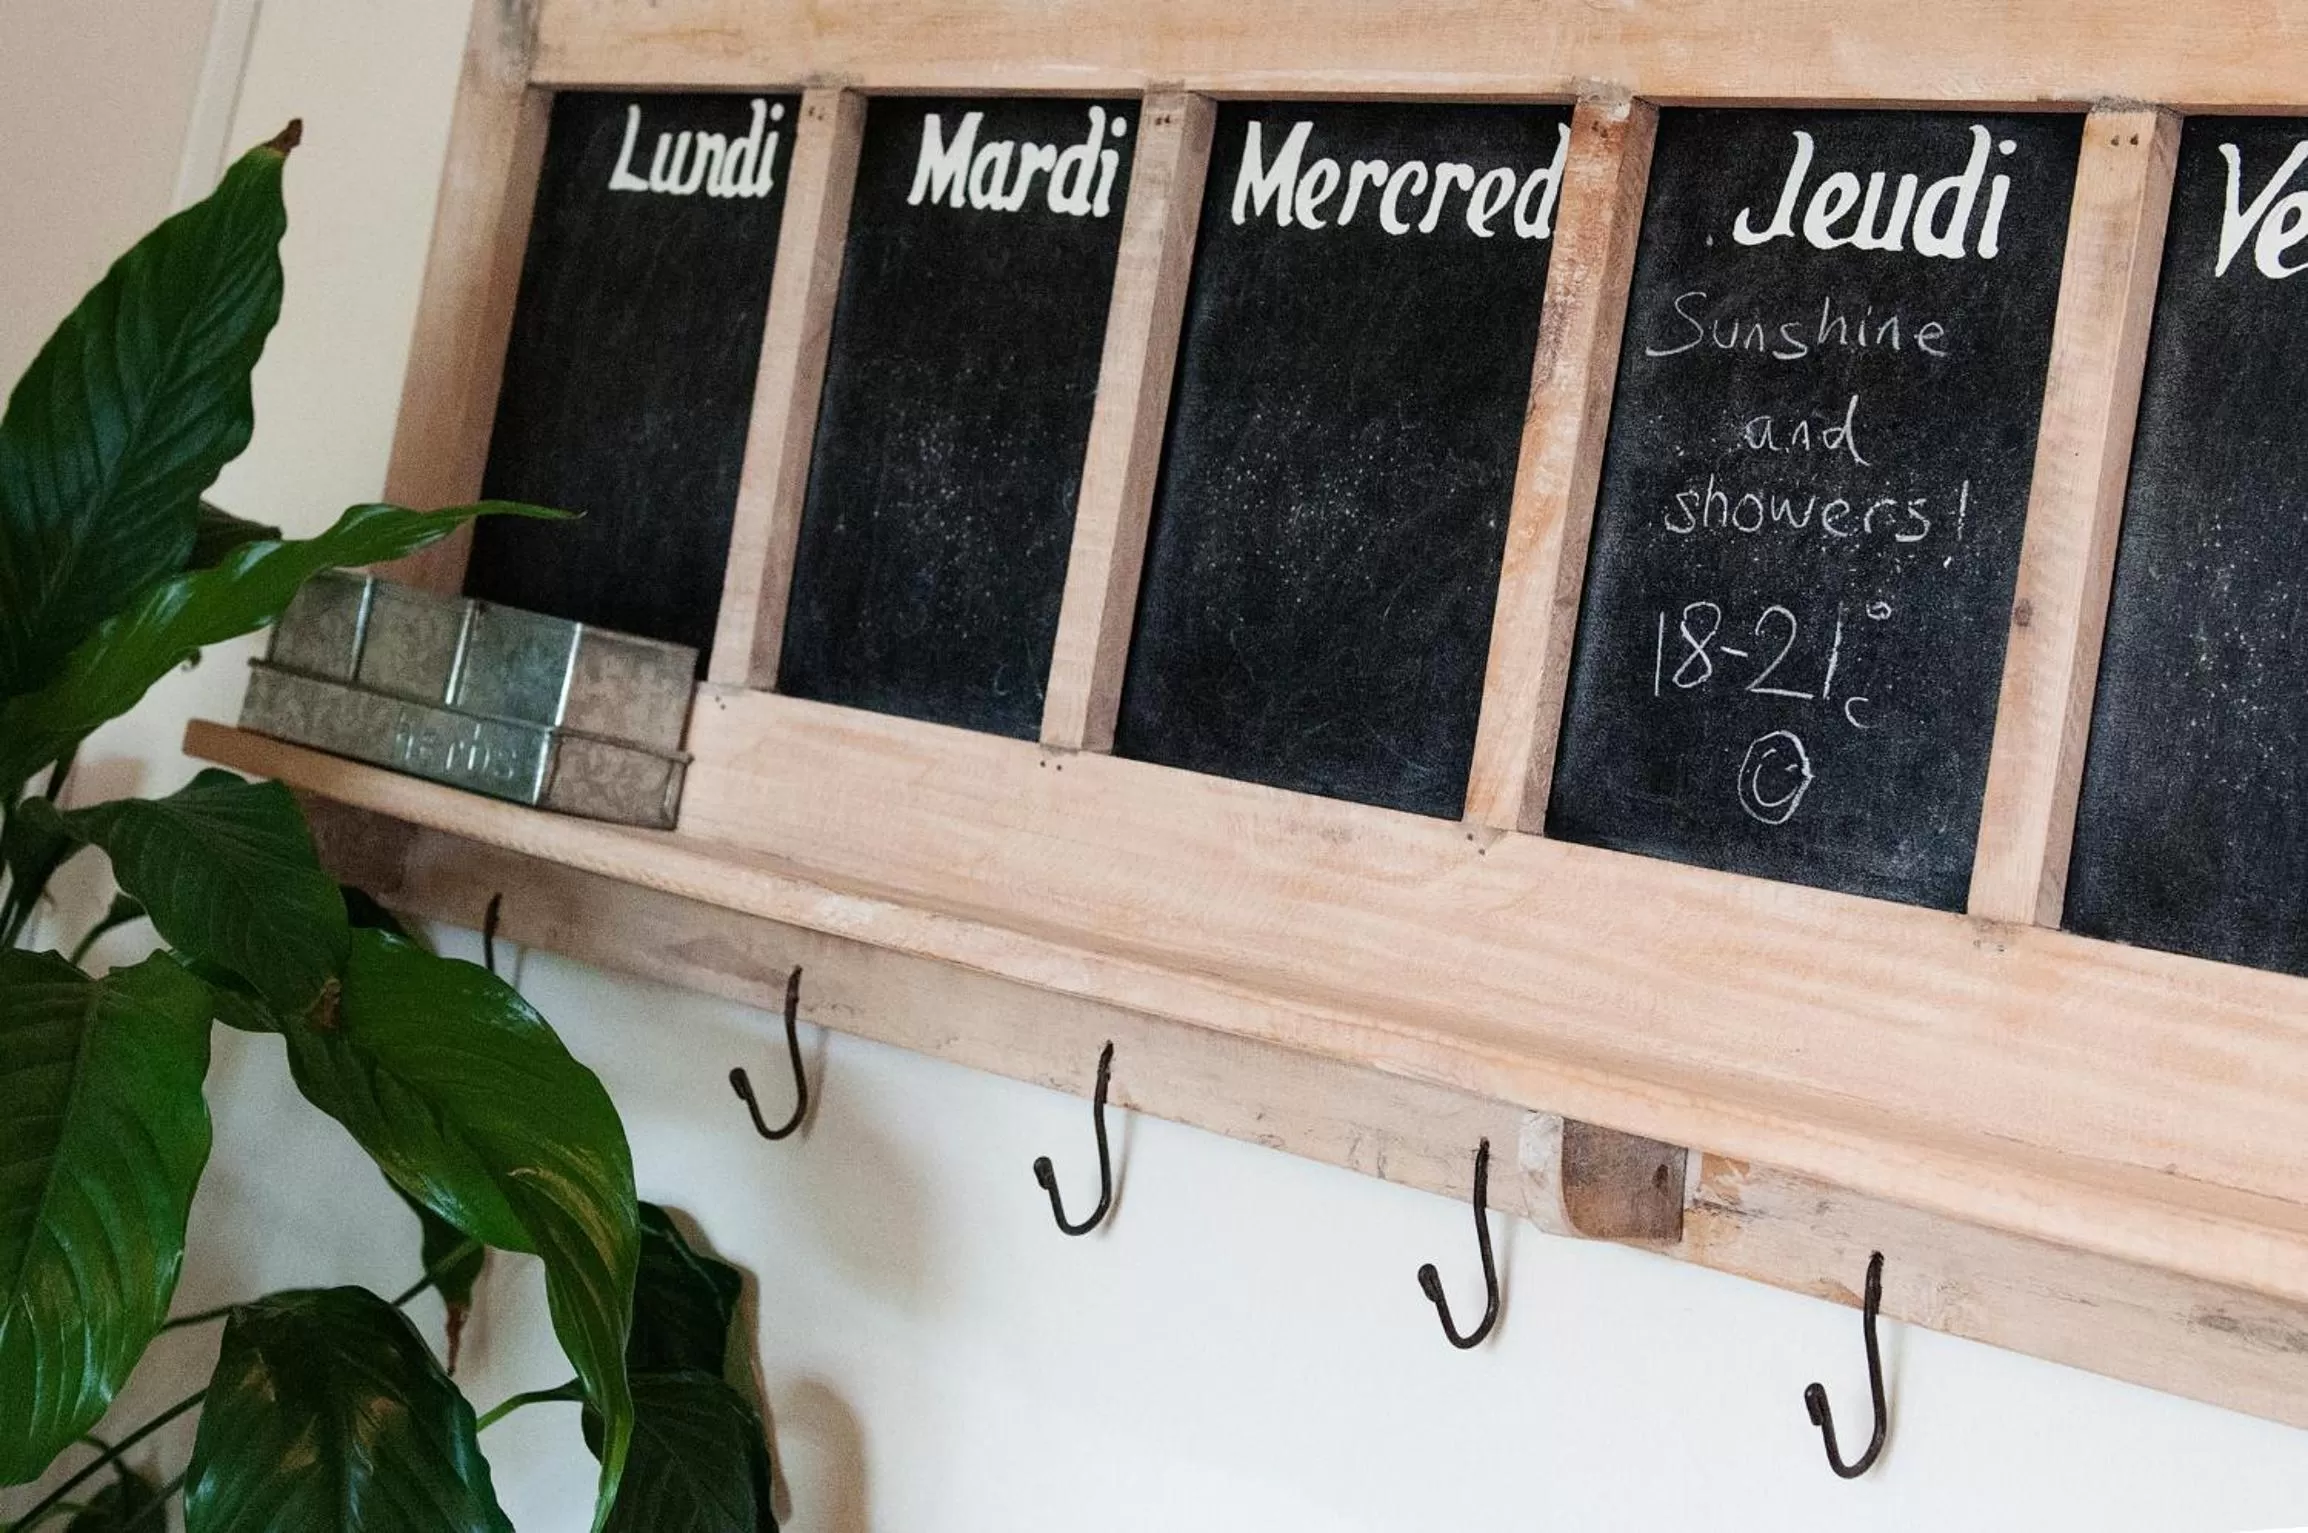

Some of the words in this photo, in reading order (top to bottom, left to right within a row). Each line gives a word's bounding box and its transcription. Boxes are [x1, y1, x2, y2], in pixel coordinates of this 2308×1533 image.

[609, 99, 784, 198] Lundi
[907, 105, 1127, 218] Mardi
[1231, 120, 1573, 239] Mercred
[1732, 124, 2018, 260] Jeudi
[1645, 291, 1950, 360] Sunshine
[1743, 394, 1871, 467] and
